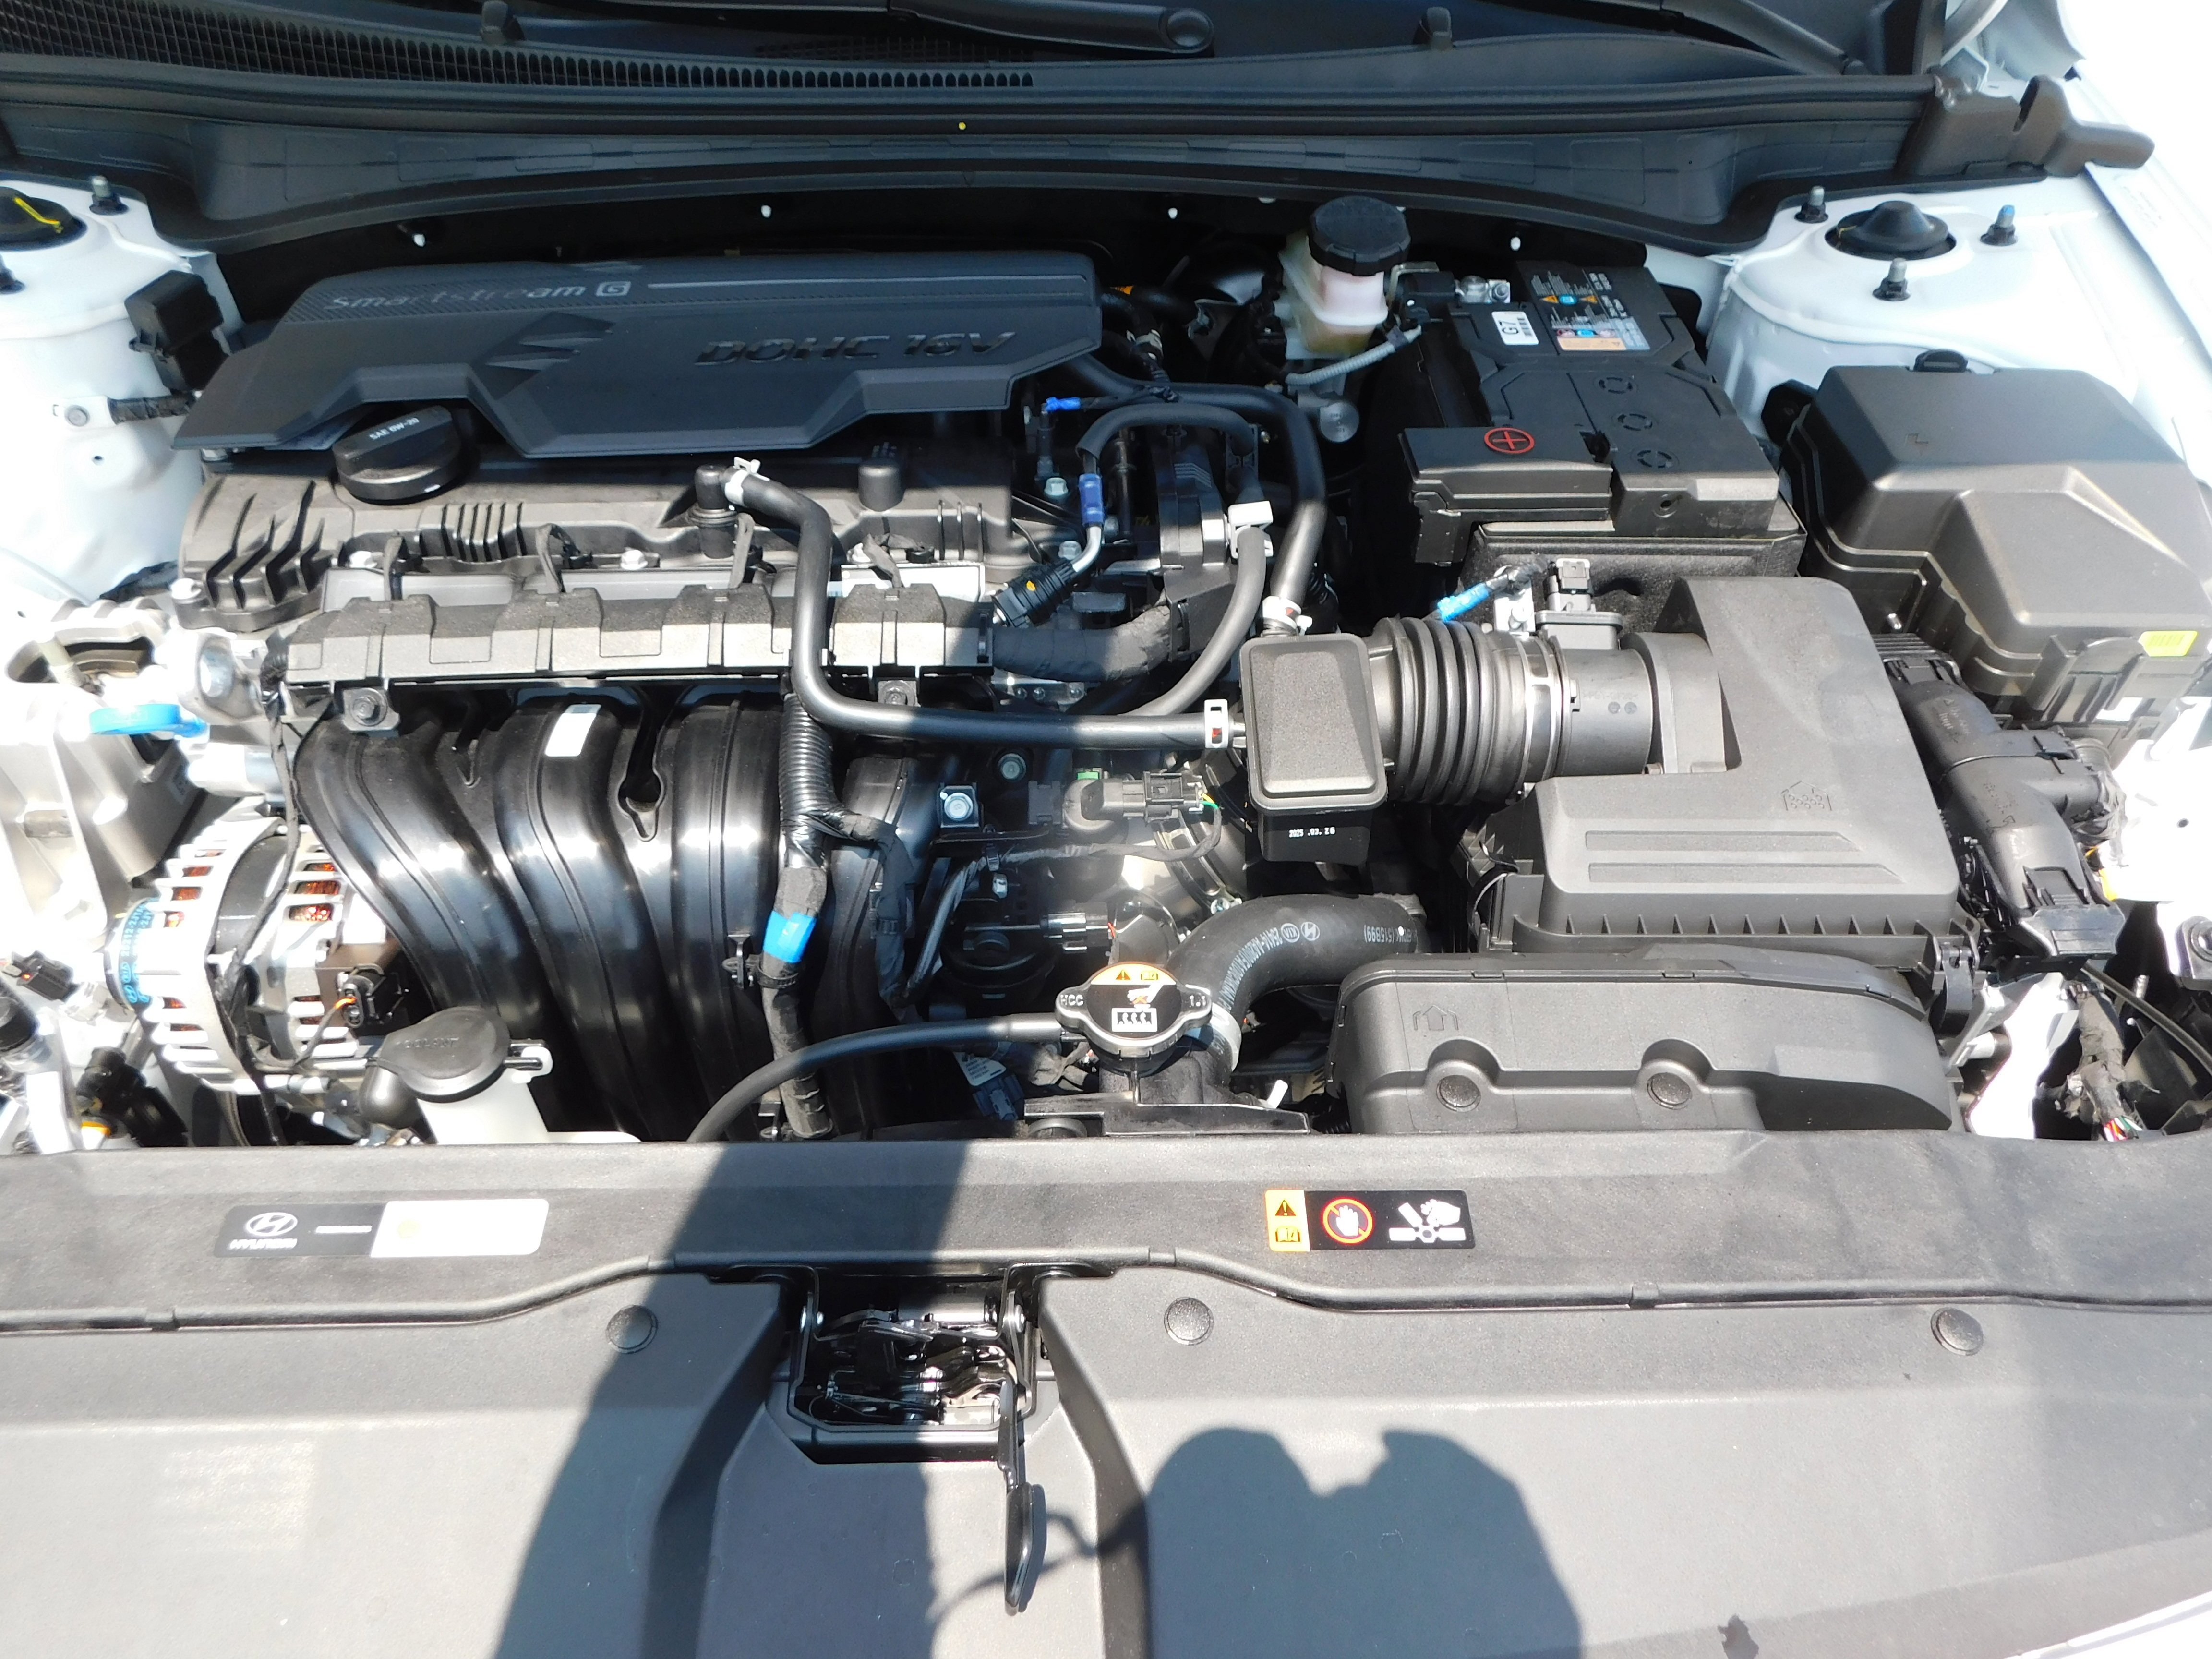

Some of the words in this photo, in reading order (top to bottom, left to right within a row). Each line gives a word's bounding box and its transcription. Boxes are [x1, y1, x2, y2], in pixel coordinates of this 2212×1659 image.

[695, 335, 890, 366] DOHC
[905, 332, 1016, 357] 16V
[1288, 829, 1304, 838] 2025
[1324, 827, 1335, 835] 26
[1060, 994, 1084, 1006] HCC
